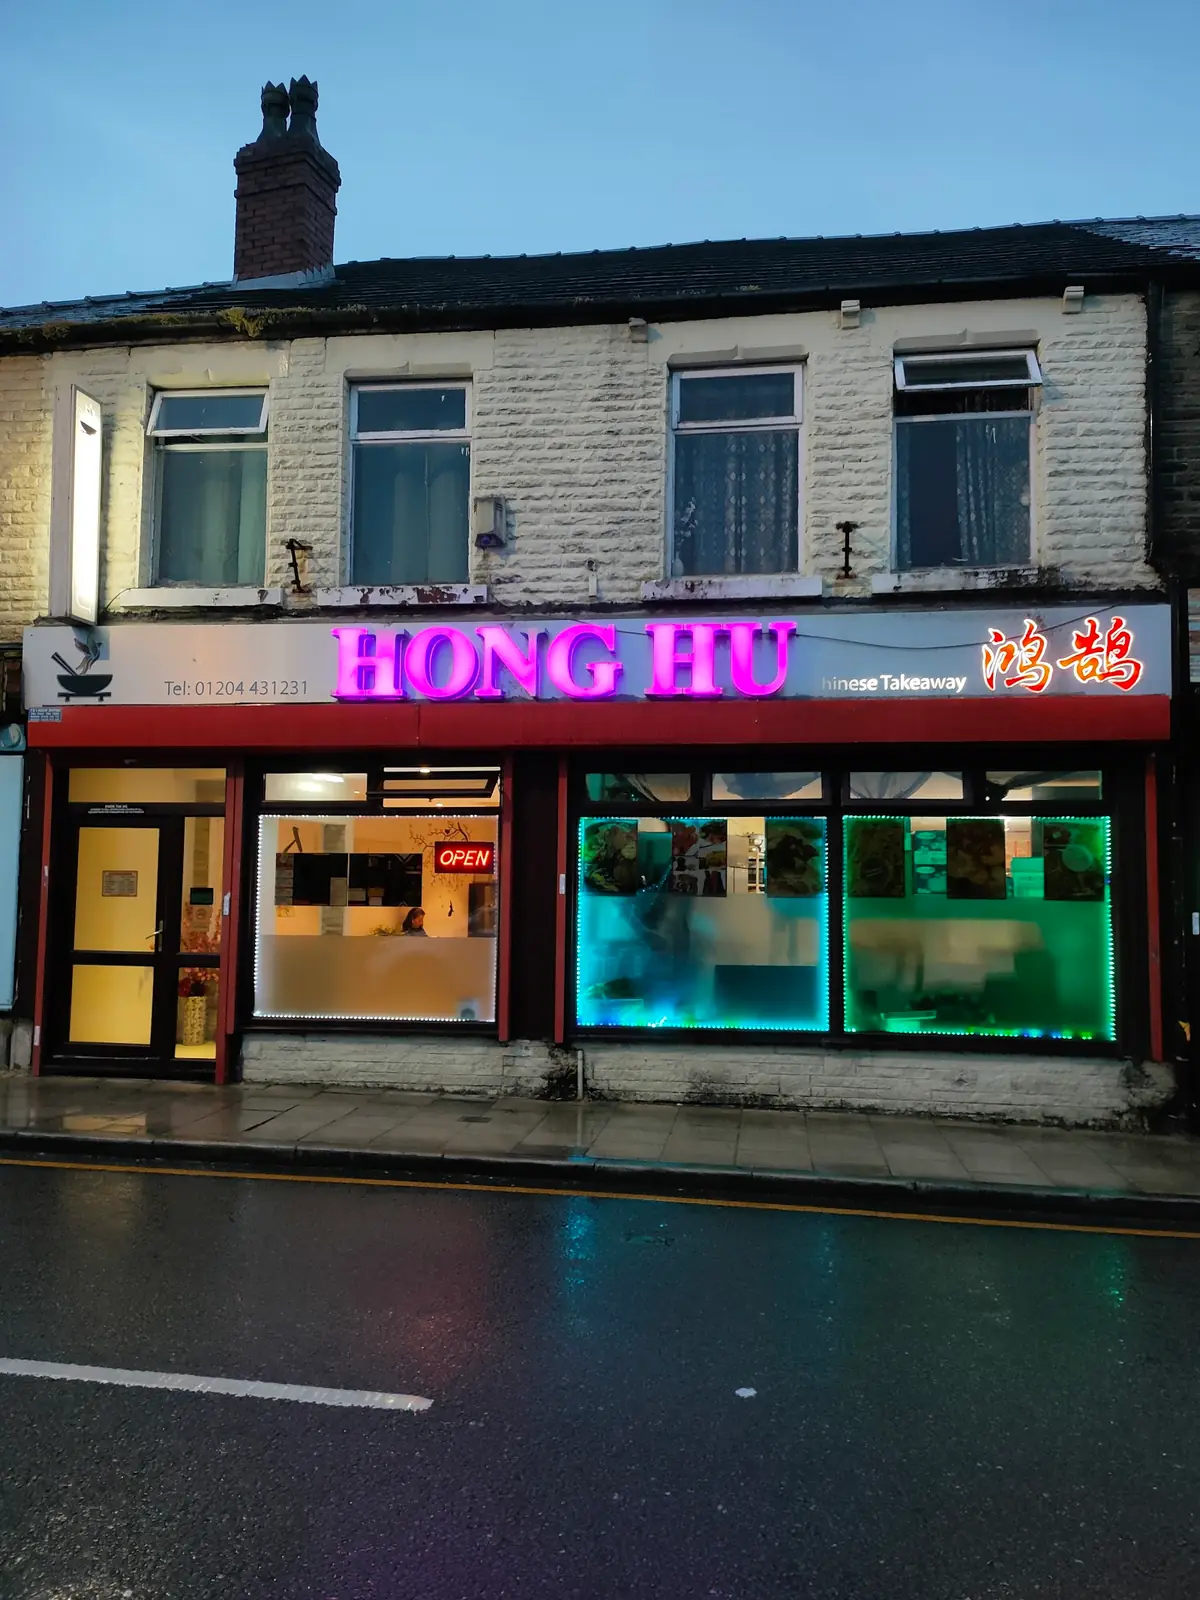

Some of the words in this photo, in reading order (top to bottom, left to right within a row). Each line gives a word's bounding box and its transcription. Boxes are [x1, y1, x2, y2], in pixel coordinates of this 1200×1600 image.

[331, 624, 623, 699] HONG
[644, 622, 797, 696] HU
[164, 680, 191, 696] Tel:
[195, 681, 245, 696] 01204
[249, 680, 308, 695] 431231
[822, 675, 878, 692] hinese
[880, 673, 968, 694] Takeaway
[440, 850, 490, 867] OPEN
